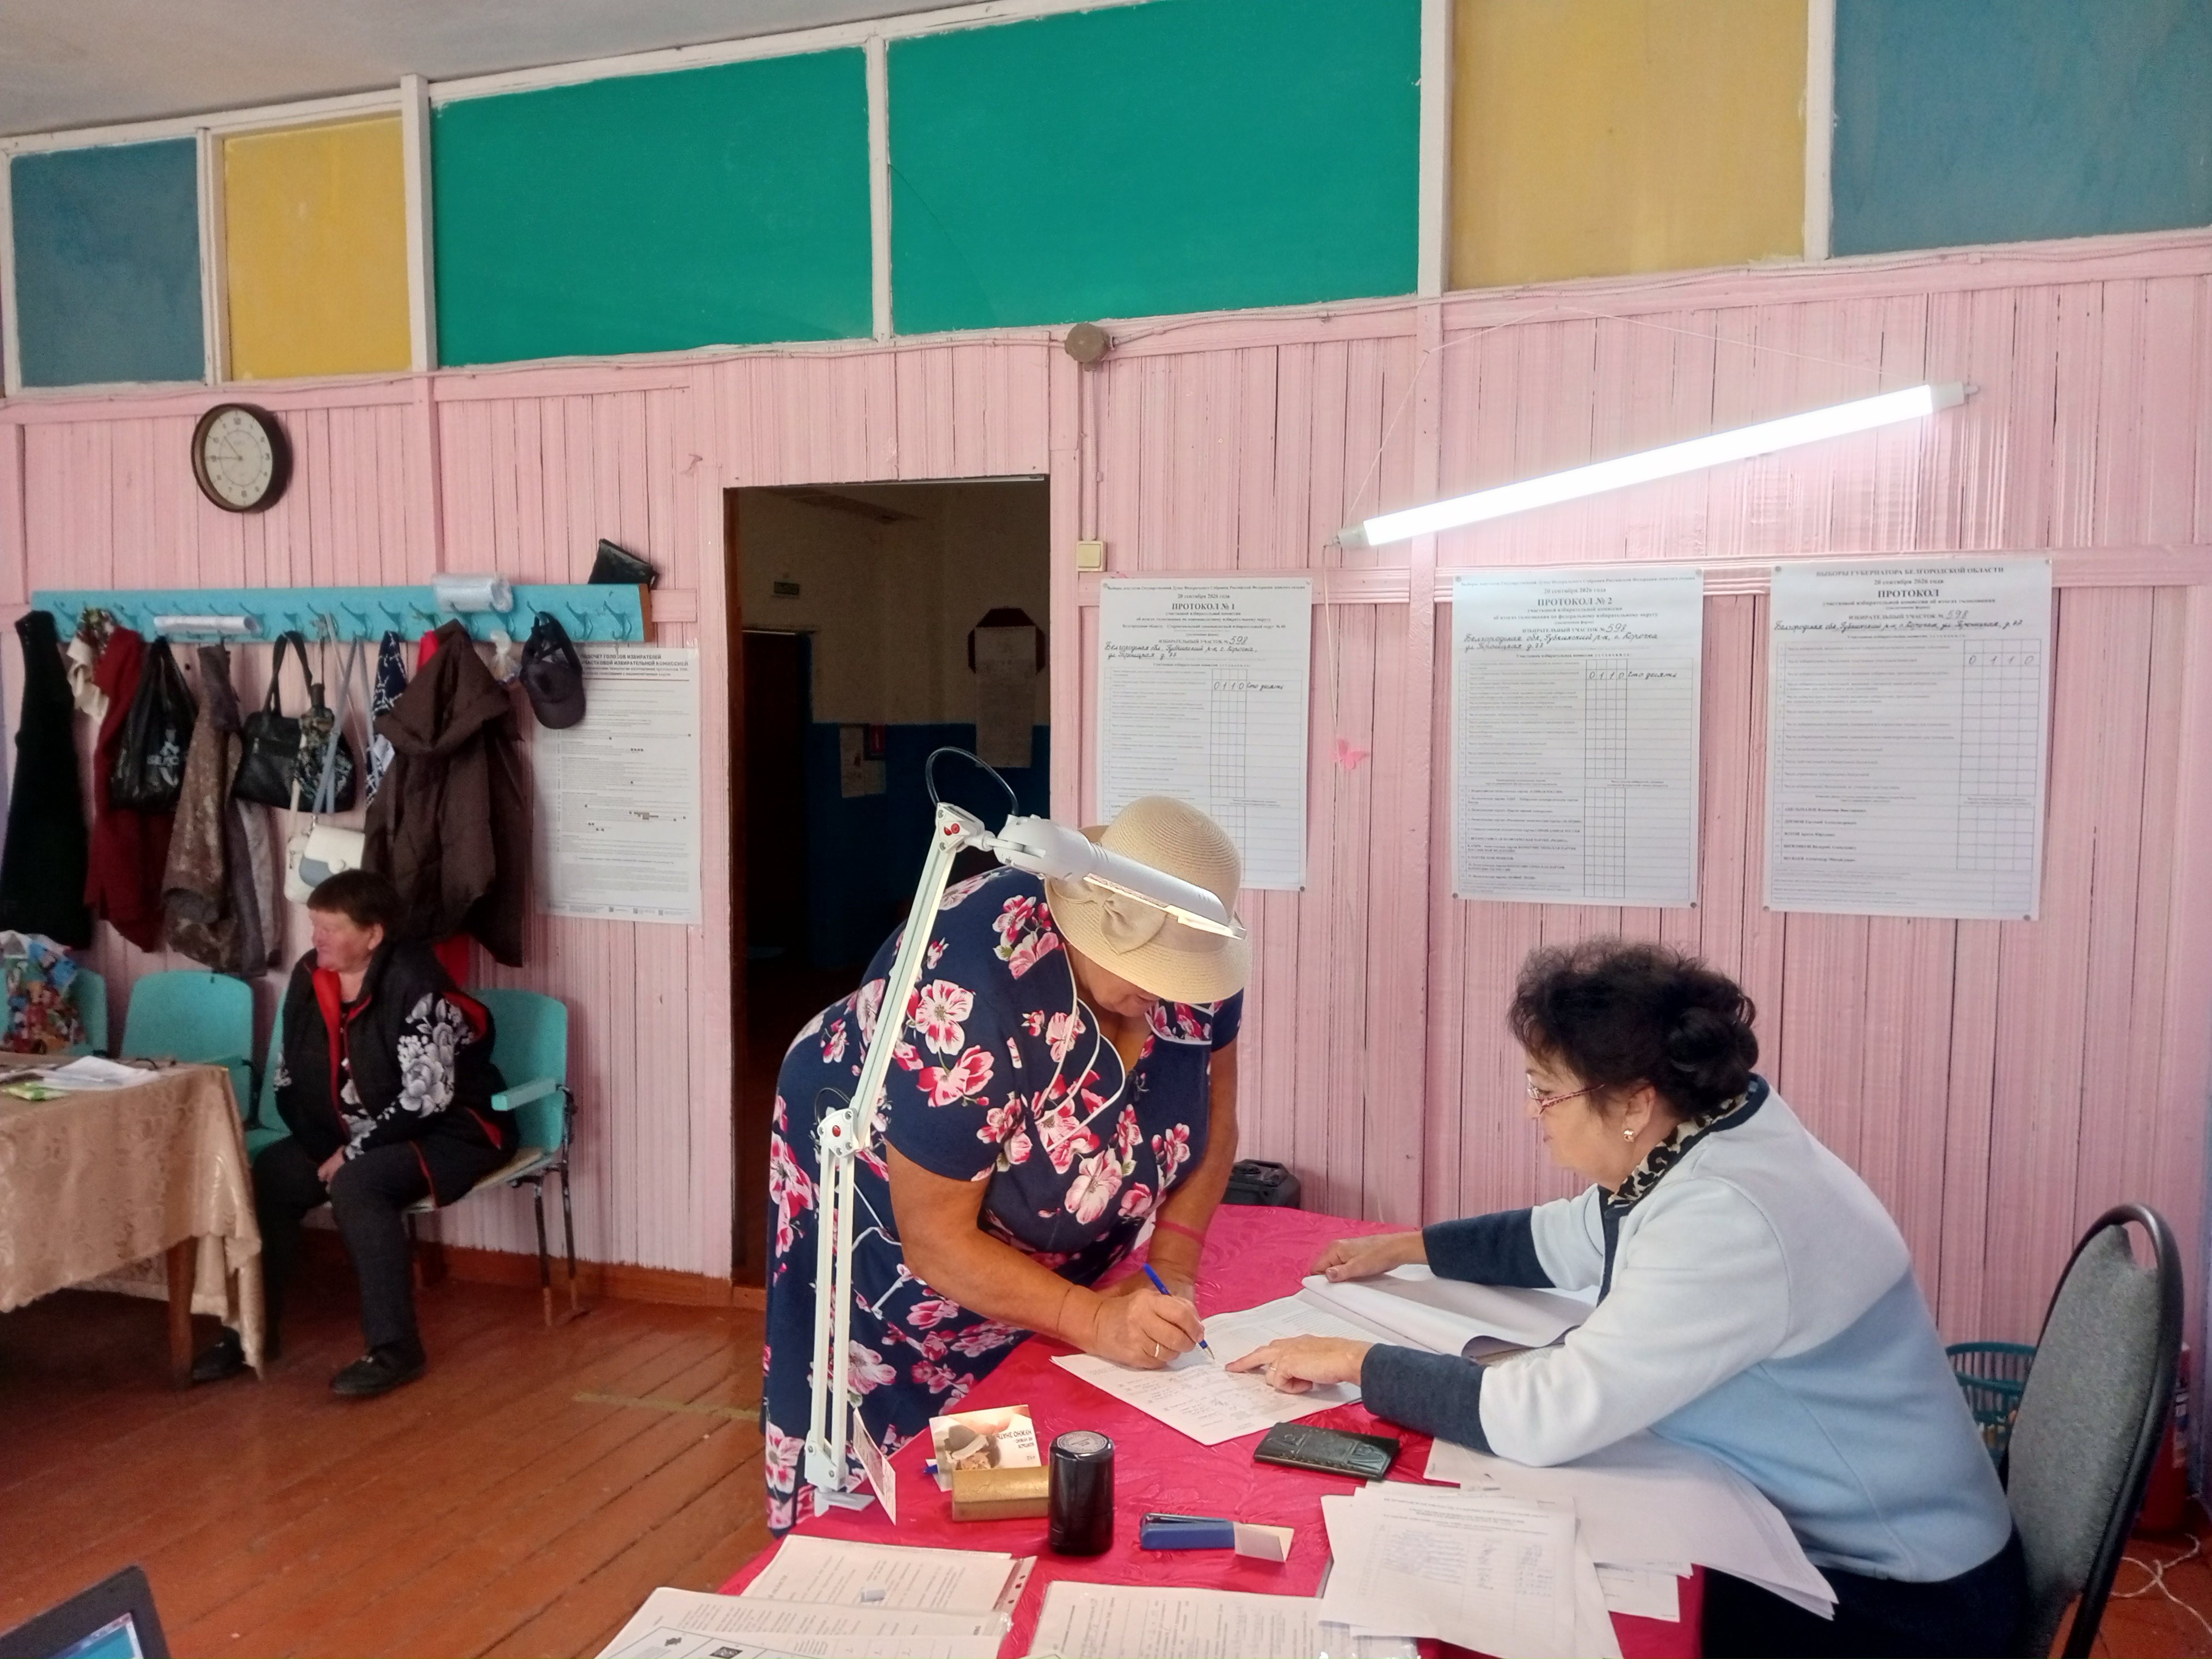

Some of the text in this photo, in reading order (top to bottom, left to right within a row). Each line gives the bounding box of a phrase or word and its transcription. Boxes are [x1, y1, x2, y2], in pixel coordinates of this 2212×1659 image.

[1877, 589, 1939, 598] ПРОТОКОЛ
[1537, 598, 1593, 606] ПРОТОКОЛ
[1945, 610, 1969, 620] 598
[1606, 623, 1627, 632] 598
[1229, 636, 1248, 645] 598
